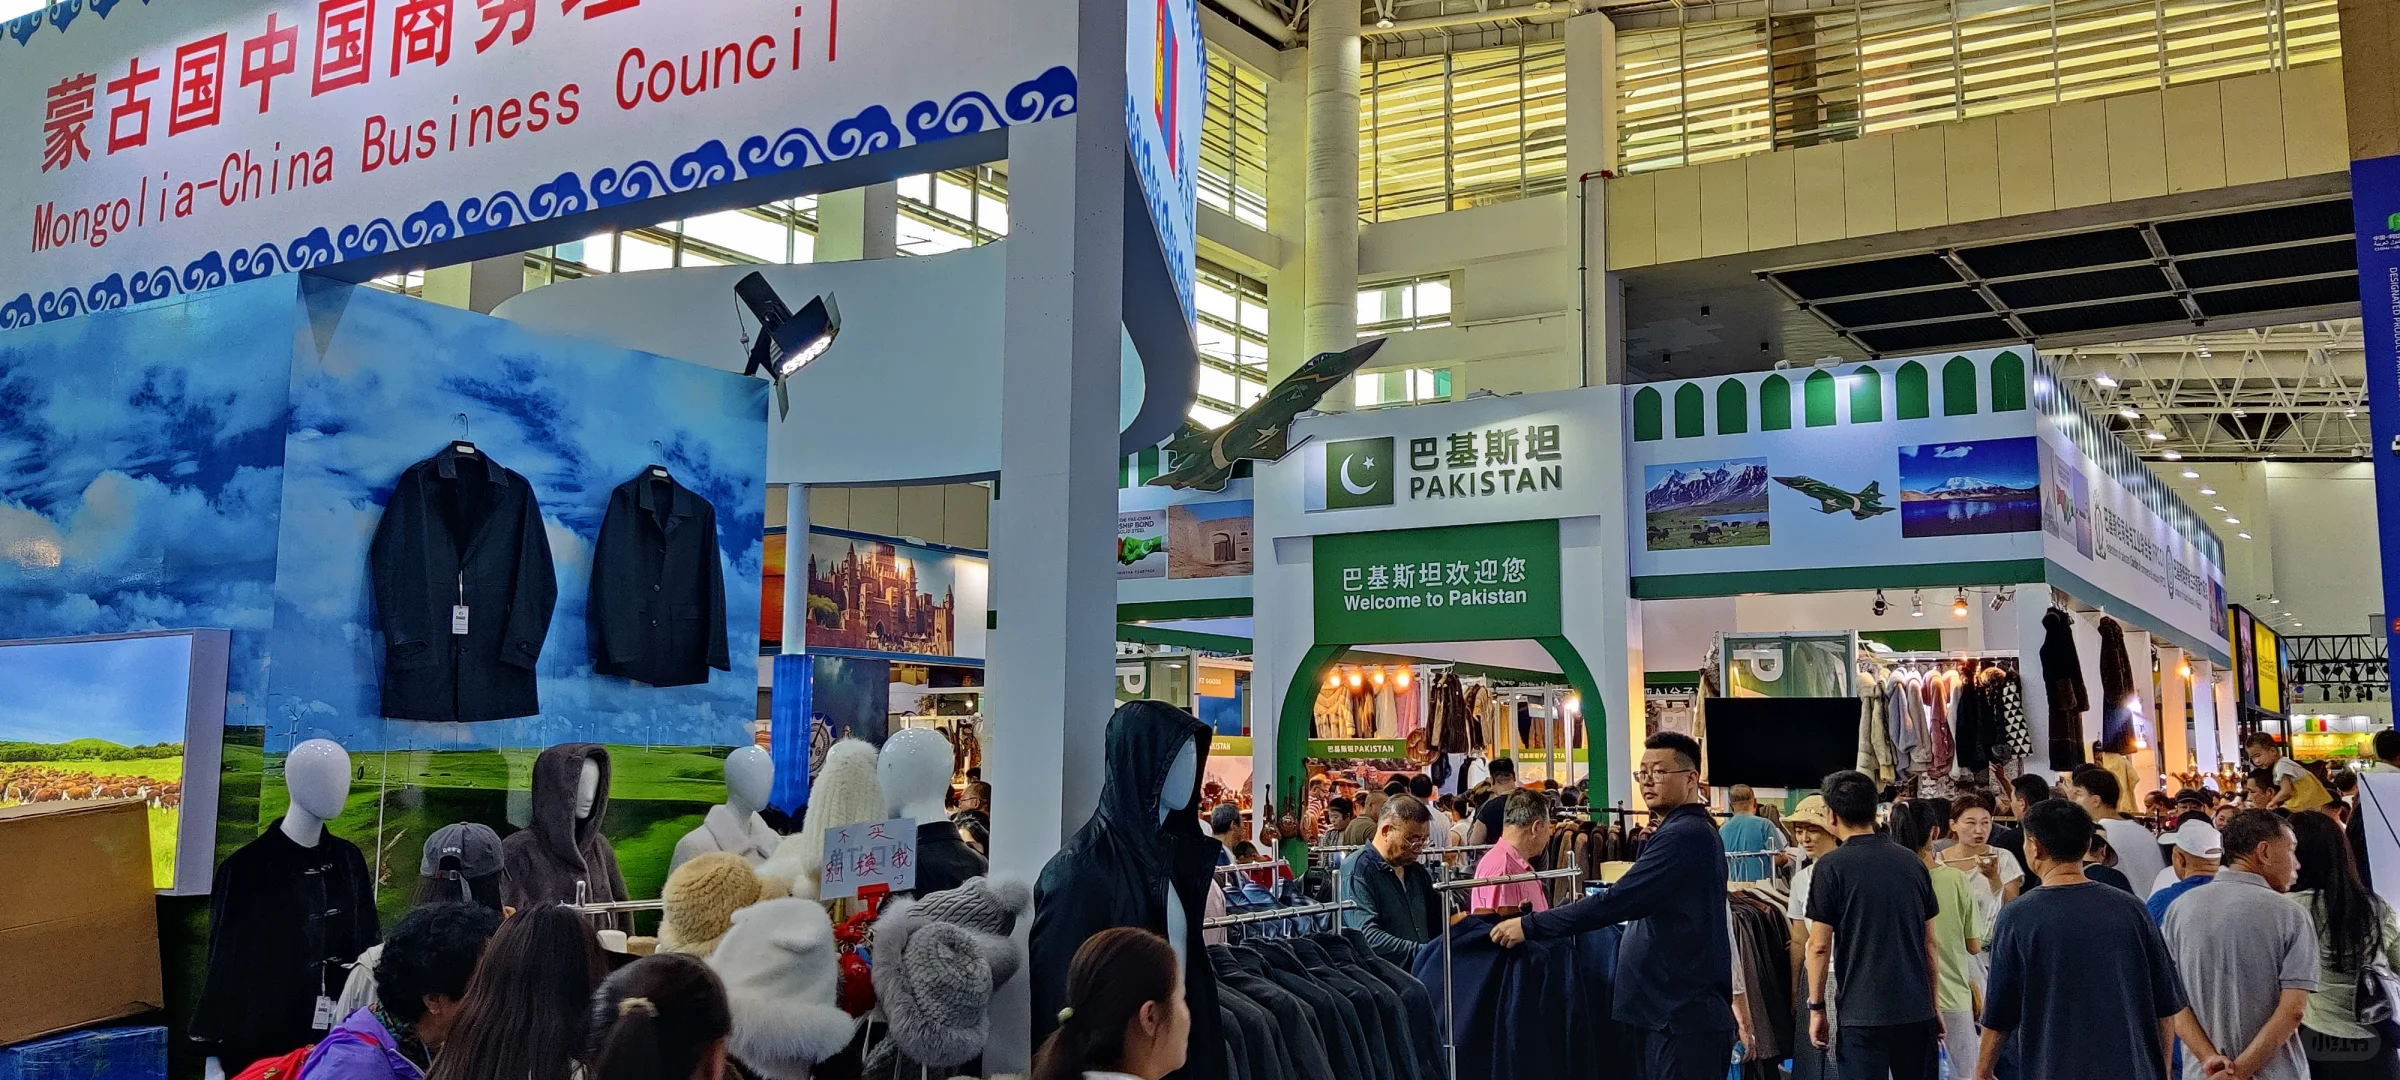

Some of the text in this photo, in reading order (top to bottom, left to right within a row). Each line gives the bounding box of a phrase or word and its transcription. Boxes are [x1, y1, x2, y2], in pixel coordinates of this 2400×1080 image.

[41, 0, 640, 174] 蒙古国中国商务
[32, 0, 838, 253] Mongolia-China Business Council
[1410, 424, 1562, 472] 巴基斯坦
[1410, 465, 1563, 501] PAKISTAN
[1135, 520, 1154, 528] BOND
[1343, 556, 1526, 591] 巴基斯坦欢迎您
[1344, 588, 1527, 612] Welcome to Pakistan
